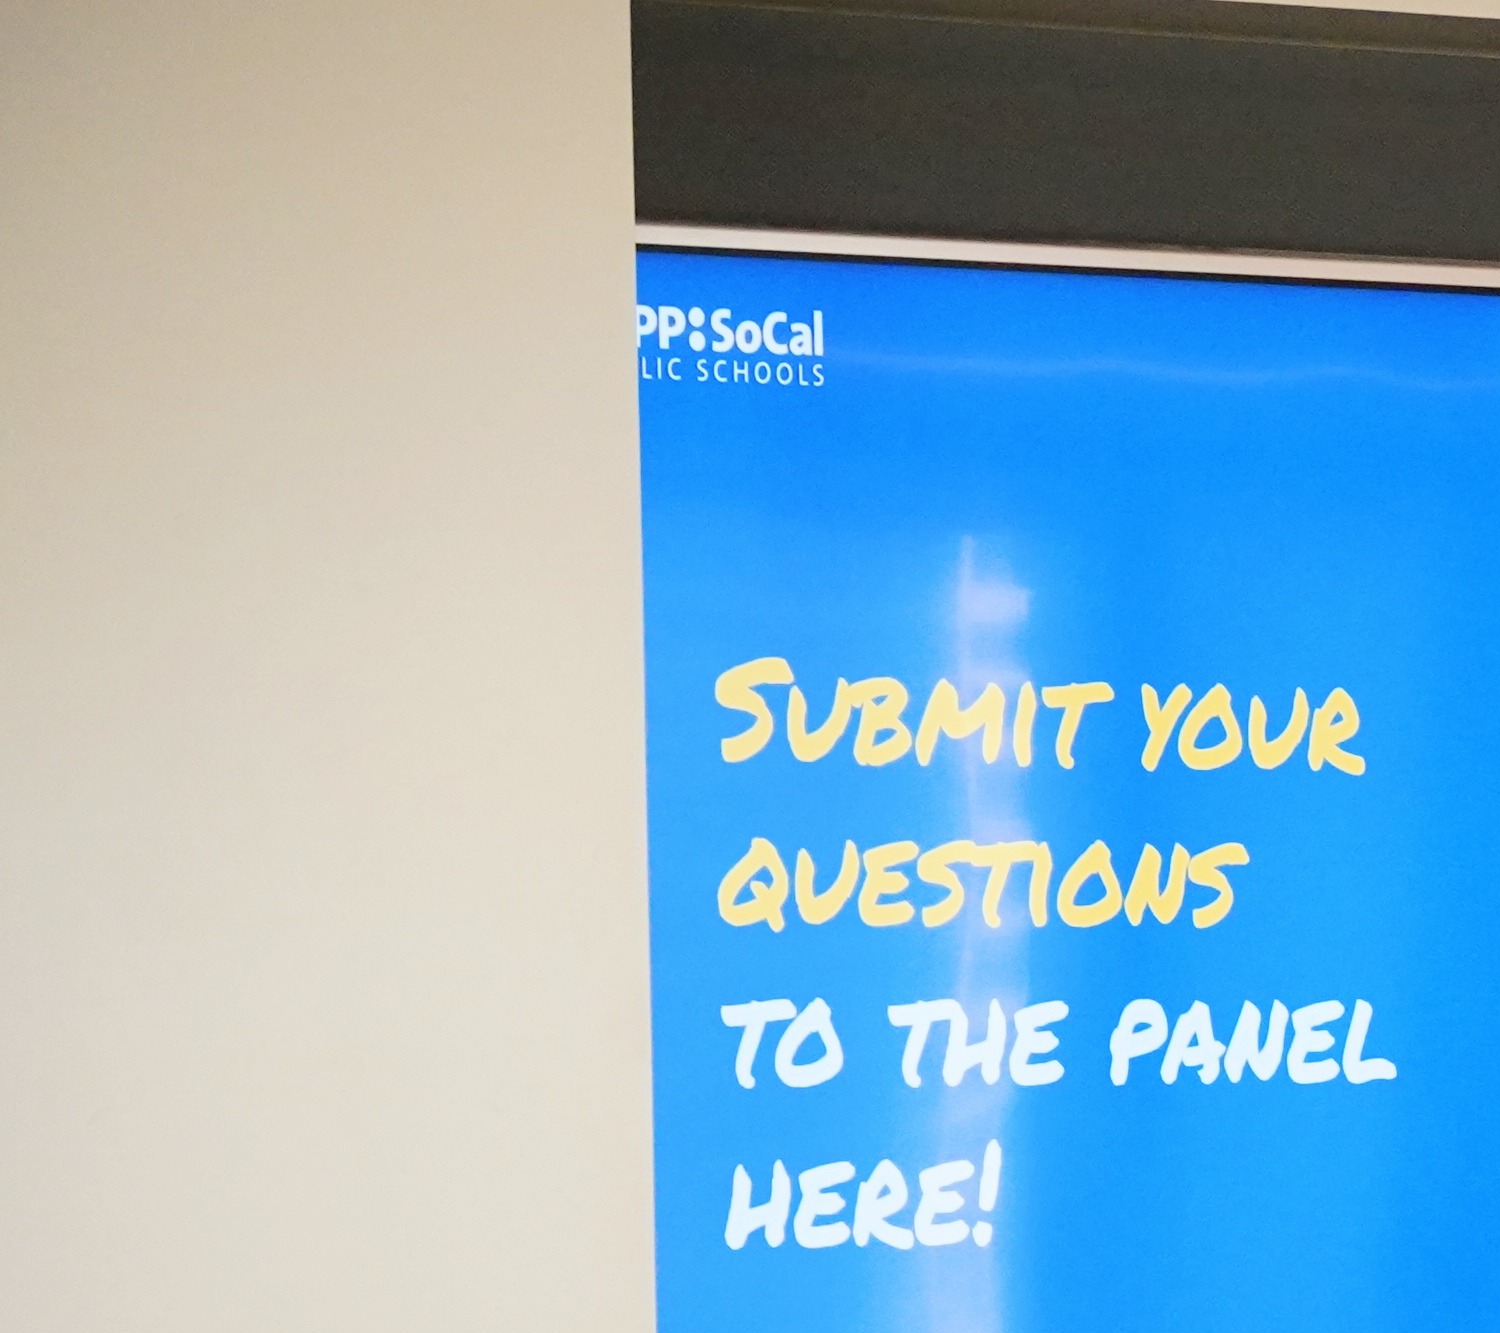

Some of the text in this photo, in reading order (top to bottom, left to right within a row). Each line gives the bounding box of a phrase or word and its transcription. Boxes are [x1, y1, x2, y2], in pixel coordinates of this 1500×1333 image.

[696, 358, 825, 387] SCHOOLS
[714, 656, 1366, 777] SUBMIT YOUR
[716, 836, 1250, 934] QUESTIONS
[719, 997, 1398, 1090] TO THE PANEL
[723, 1137, 1002, 1251] HERE!
